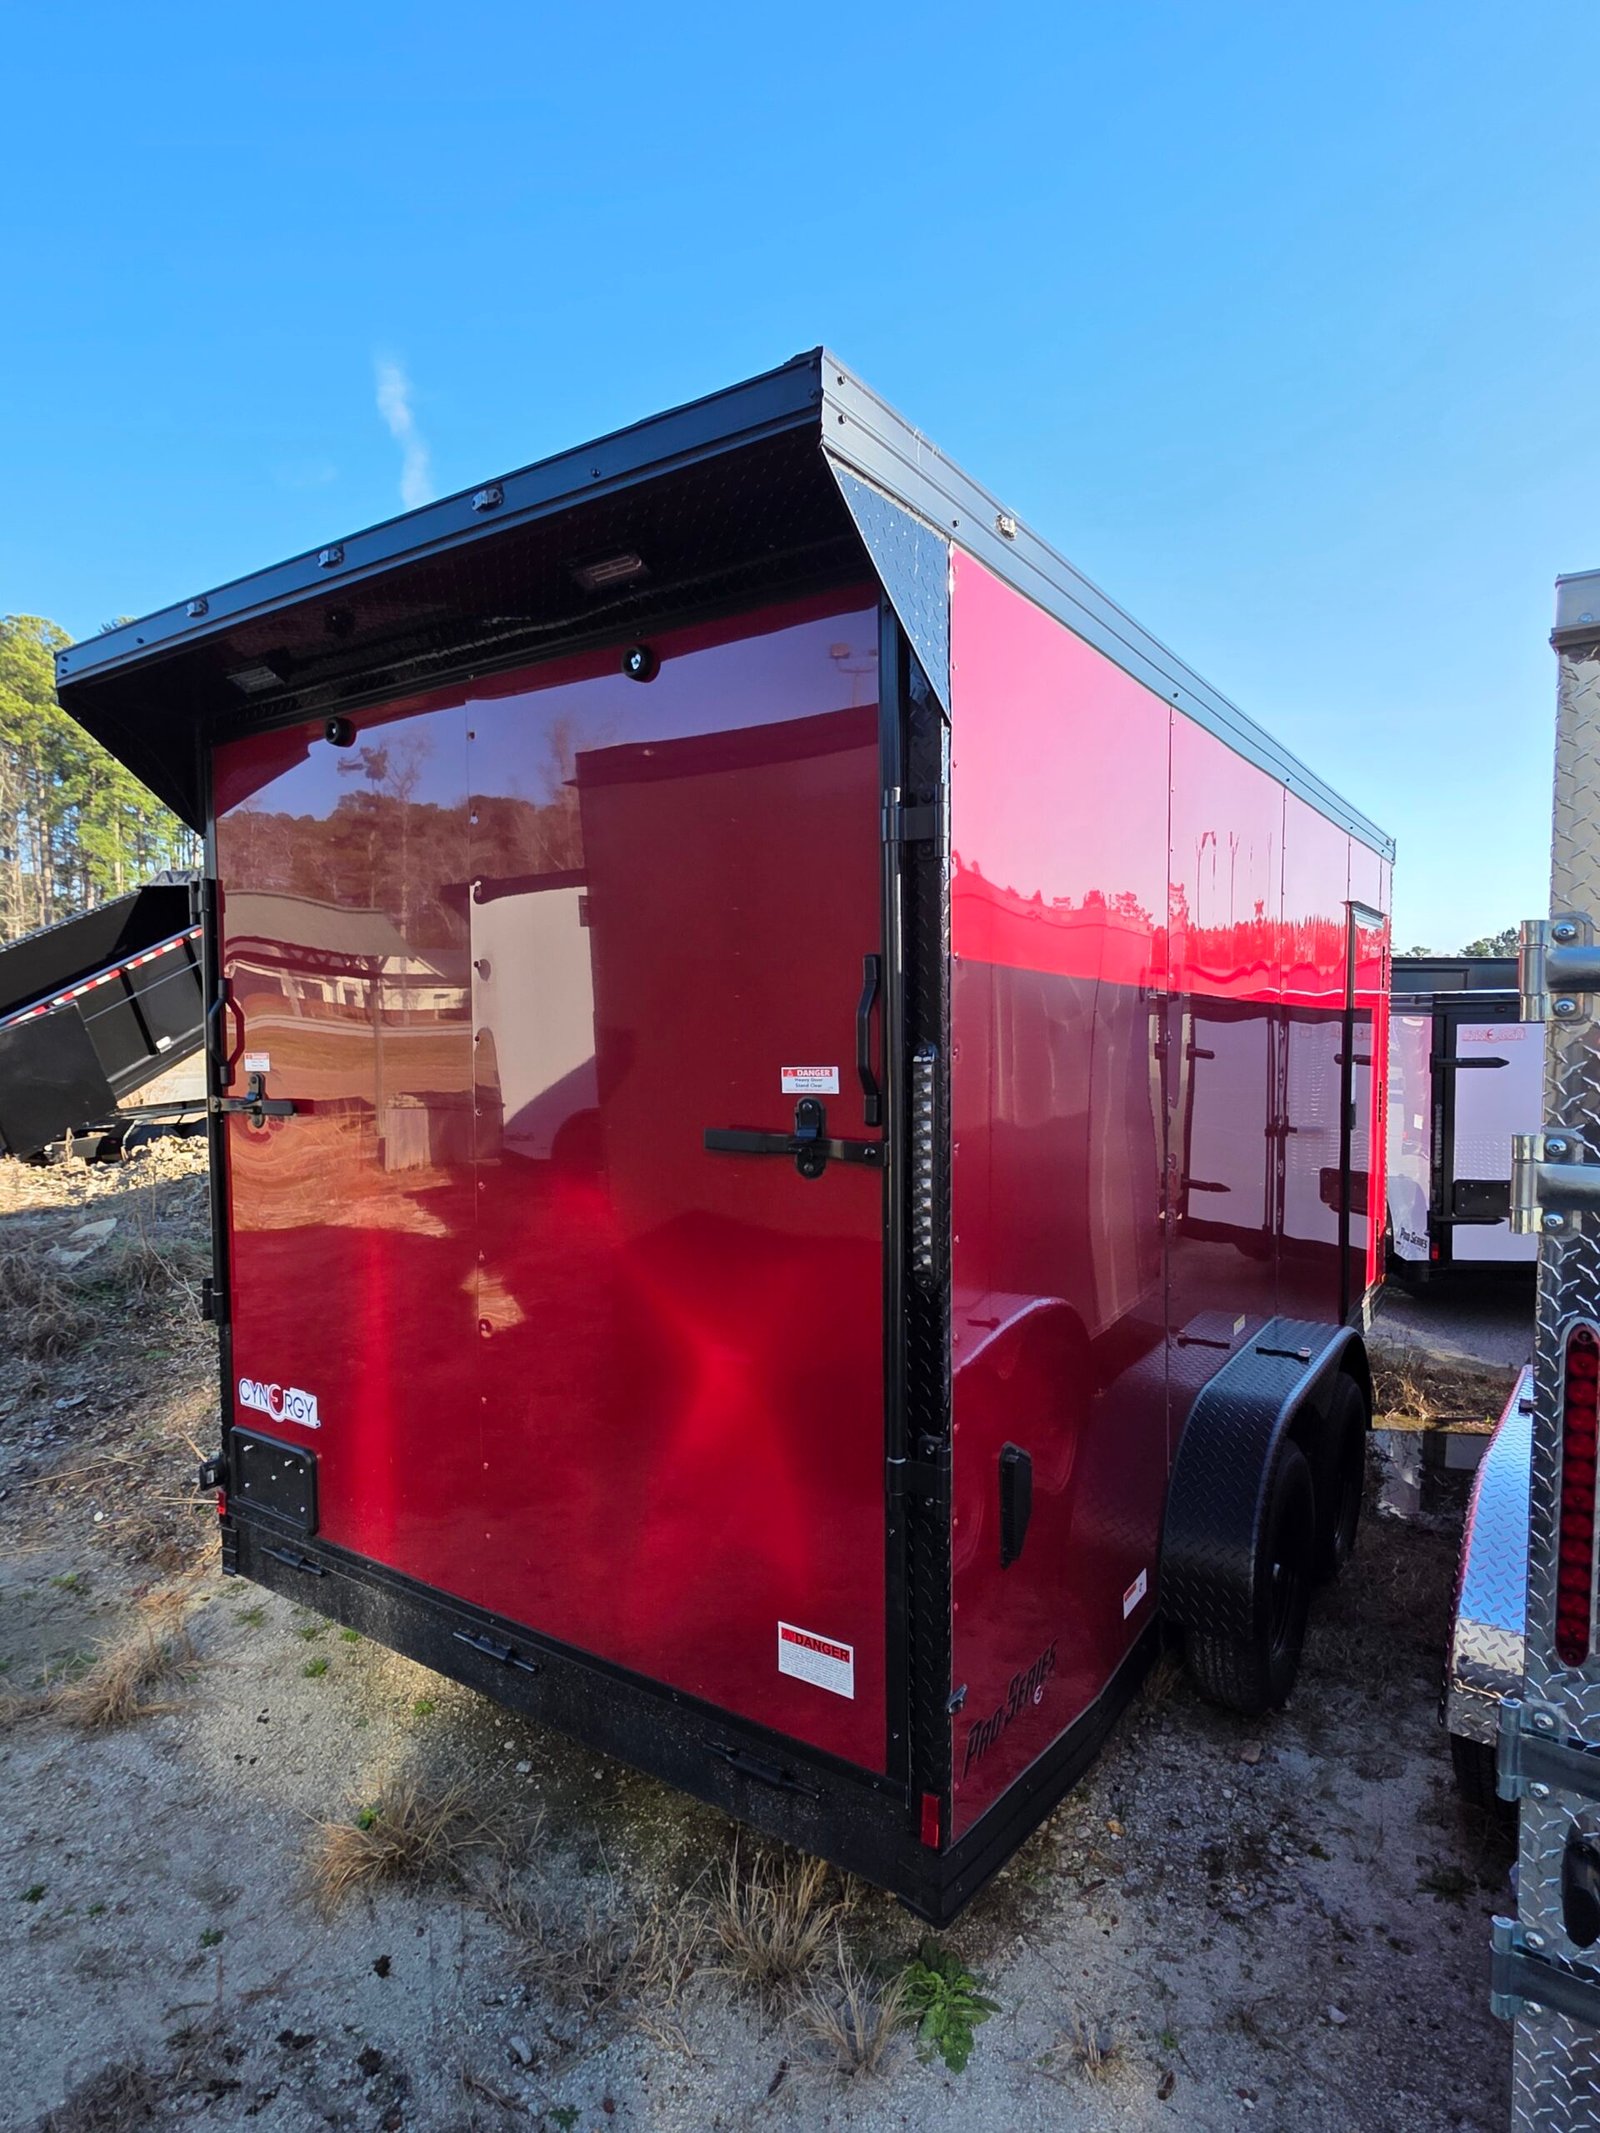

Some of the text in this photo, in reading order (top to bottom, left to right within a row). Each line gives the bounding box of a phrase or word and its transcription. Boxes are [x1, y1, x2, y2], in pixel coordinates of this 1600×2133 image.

[797, 1069, 831, 1077] DANGER
[240, 1379, 315, 1424] CYNERGY
[795, 1632, 850, 1664] DANGER
